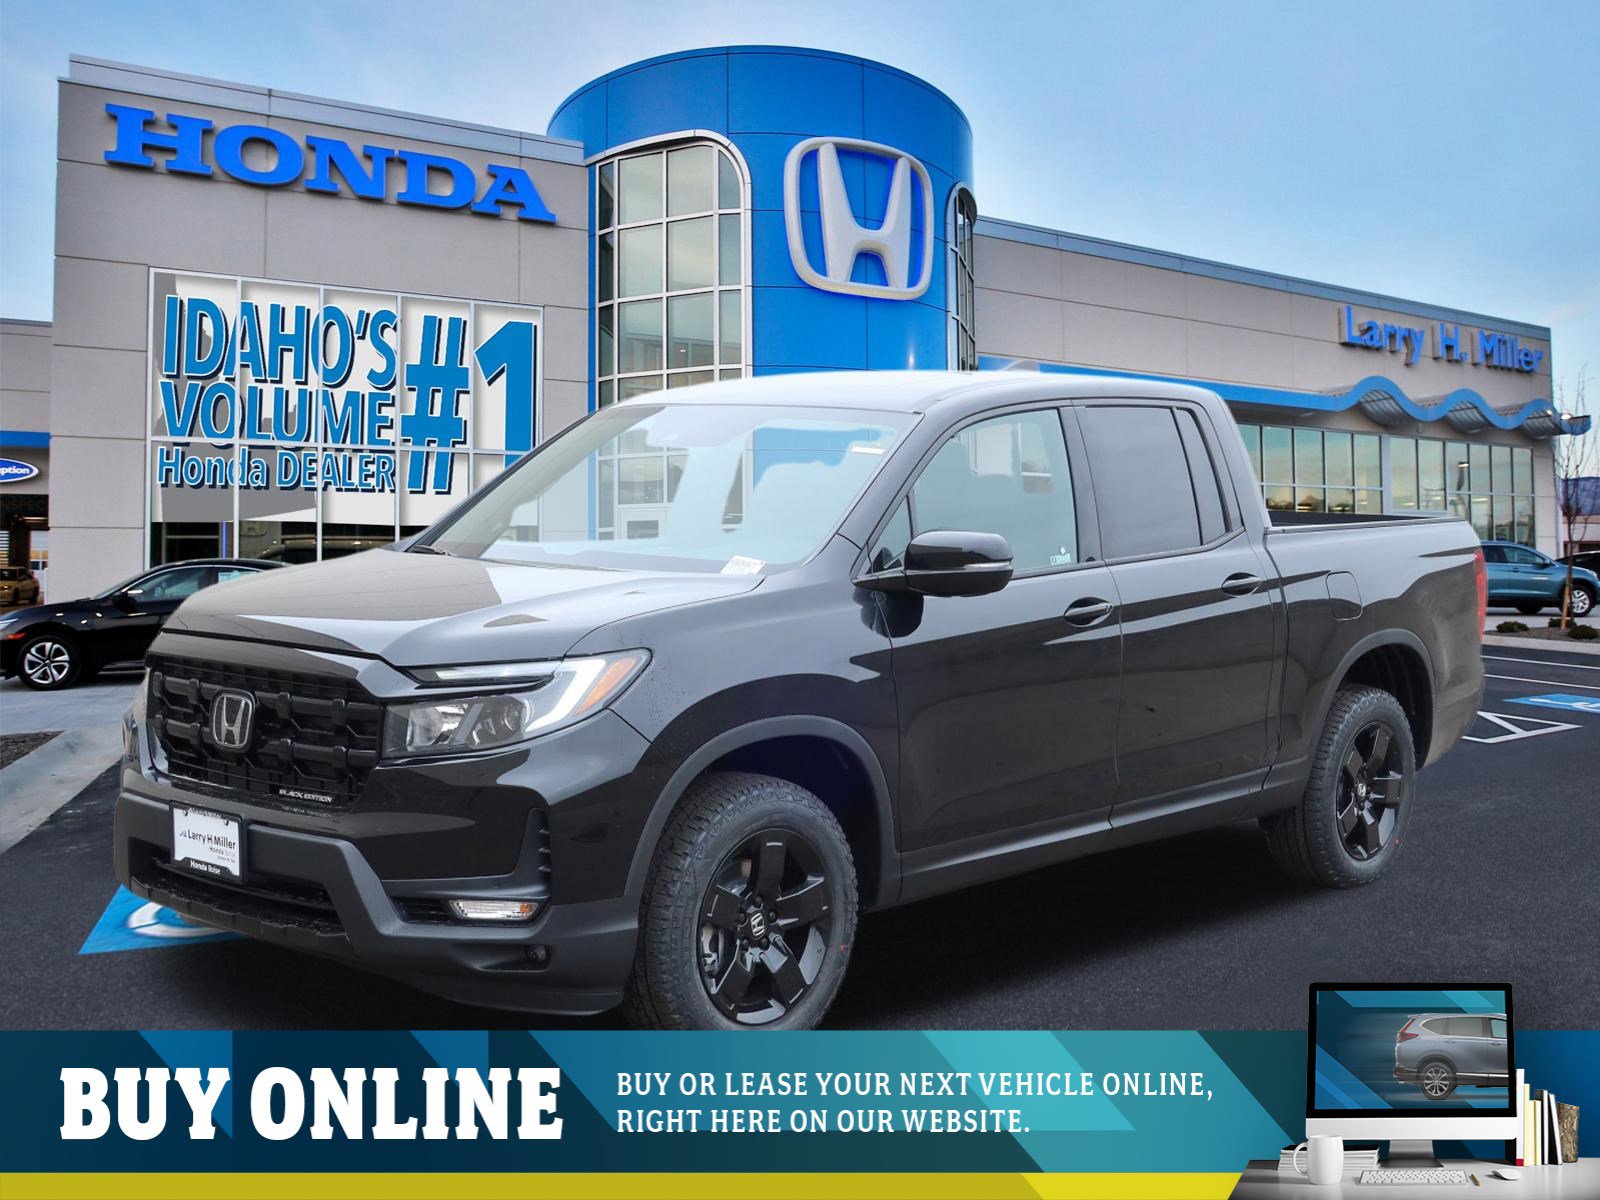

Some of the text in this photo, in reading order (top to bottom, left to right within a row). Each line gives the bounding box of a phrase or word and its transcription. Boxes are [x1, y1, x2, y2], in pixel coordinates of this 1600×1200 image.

[104, 103, 557, 223] HONDA
[161, 293, 399, 387] IDAHO'S
[1340, 305, 1545, 372] Larry H. Miller
[159, 380, 398, 449] VOLUME
[400, 313, 541, 494] #1
[0, 466, 30, 476] ption
[156, 446, 396, 493] Honda DEALER
[279, 788, 333, 803] BLACK EDITION
[188, 829, 206, 845] Larry
[214, 836, 236, 850] Miller
[190, 860, 208, 872] Honda
